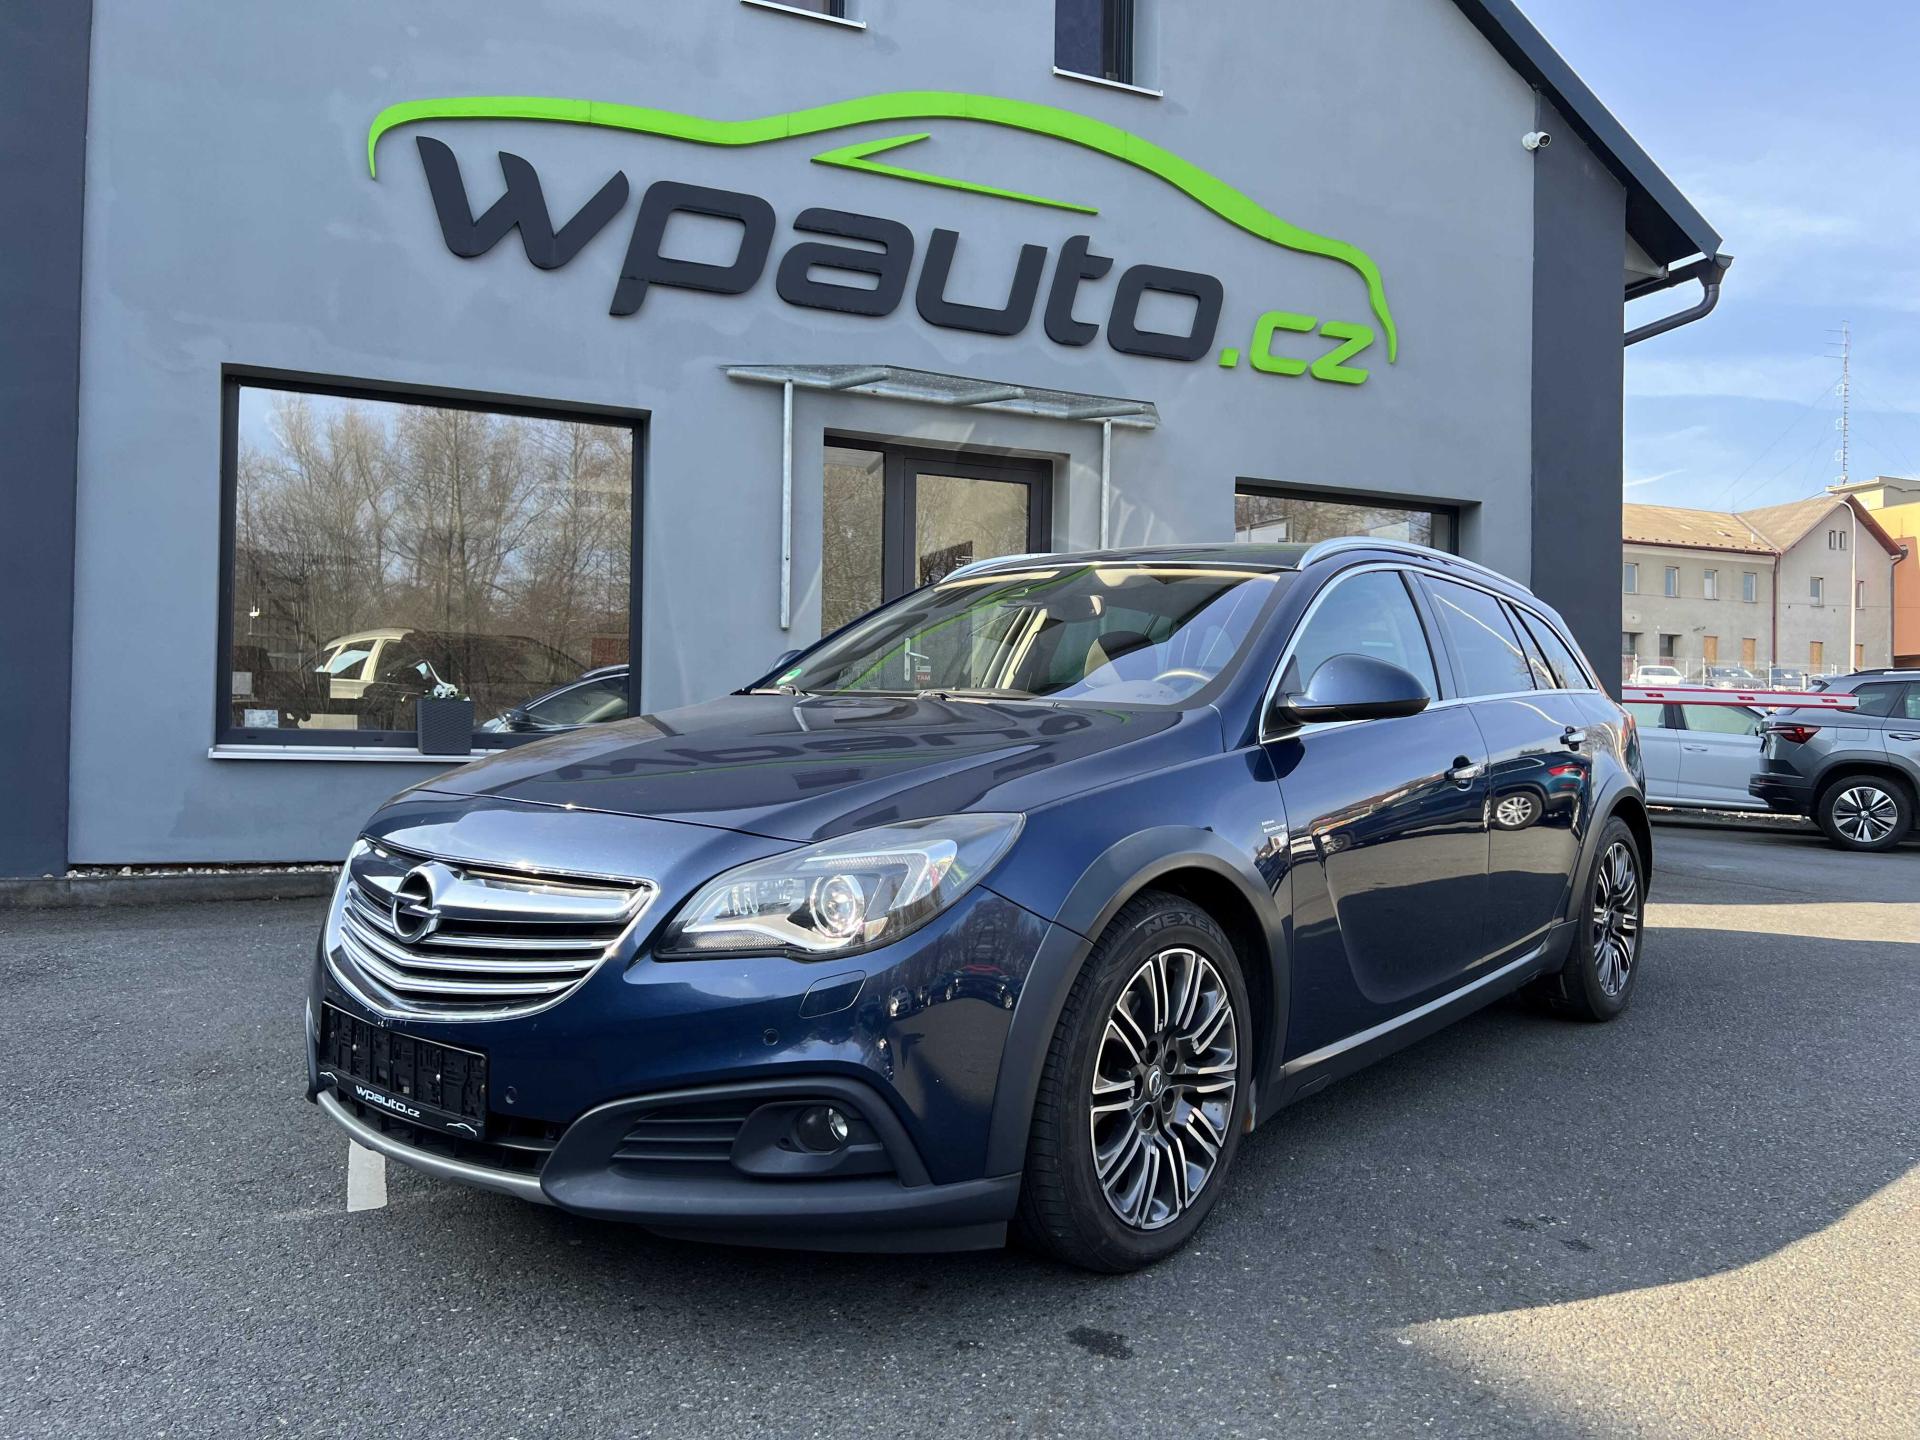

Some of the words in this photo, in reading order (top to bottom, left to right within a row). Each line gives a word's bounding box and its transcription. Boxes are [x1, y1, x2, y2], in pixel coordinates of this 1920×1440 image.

[415, 135, 1375, 386] wpauto.cz
[1143, 912, 1222, 945] NEXEN
[355, 1085, 420, 1118] wpauto.cz
